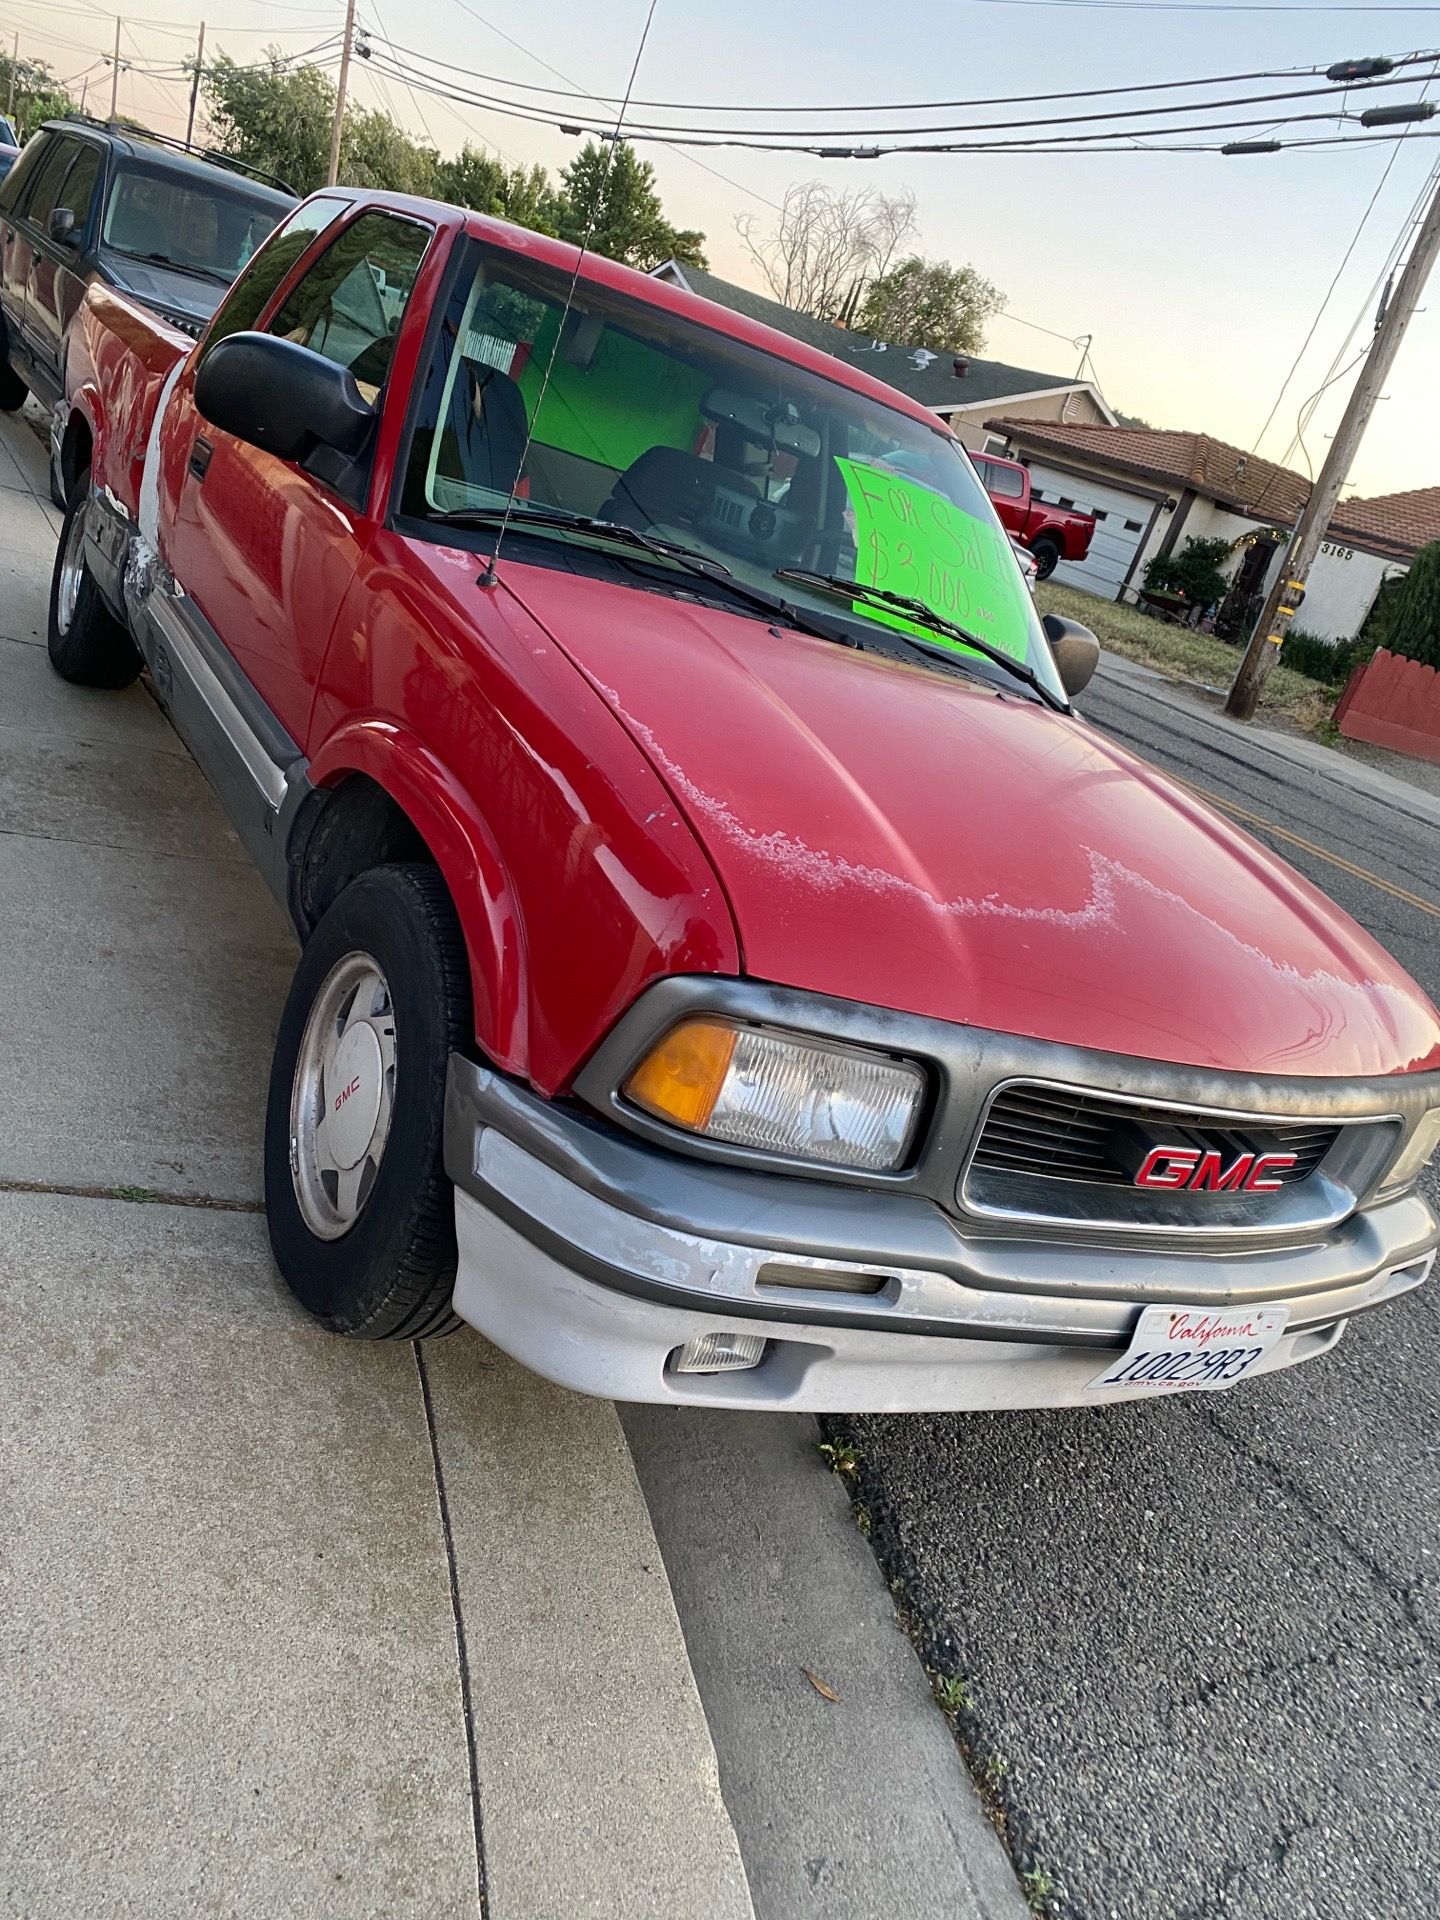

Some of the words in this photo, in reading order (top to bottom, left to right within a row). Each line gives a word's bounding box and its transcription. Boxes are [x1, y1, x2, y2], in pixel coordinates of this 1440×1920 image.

[1321, 543, 1355, 561] 3165
[335, 1075, 360, 1111] GMC
[1135, 1145, 1298, 1192] GMC
[1168, 1313, 1258, 1347] California
[1123, 1379, 1202, 1388] dmv.ca.gov
